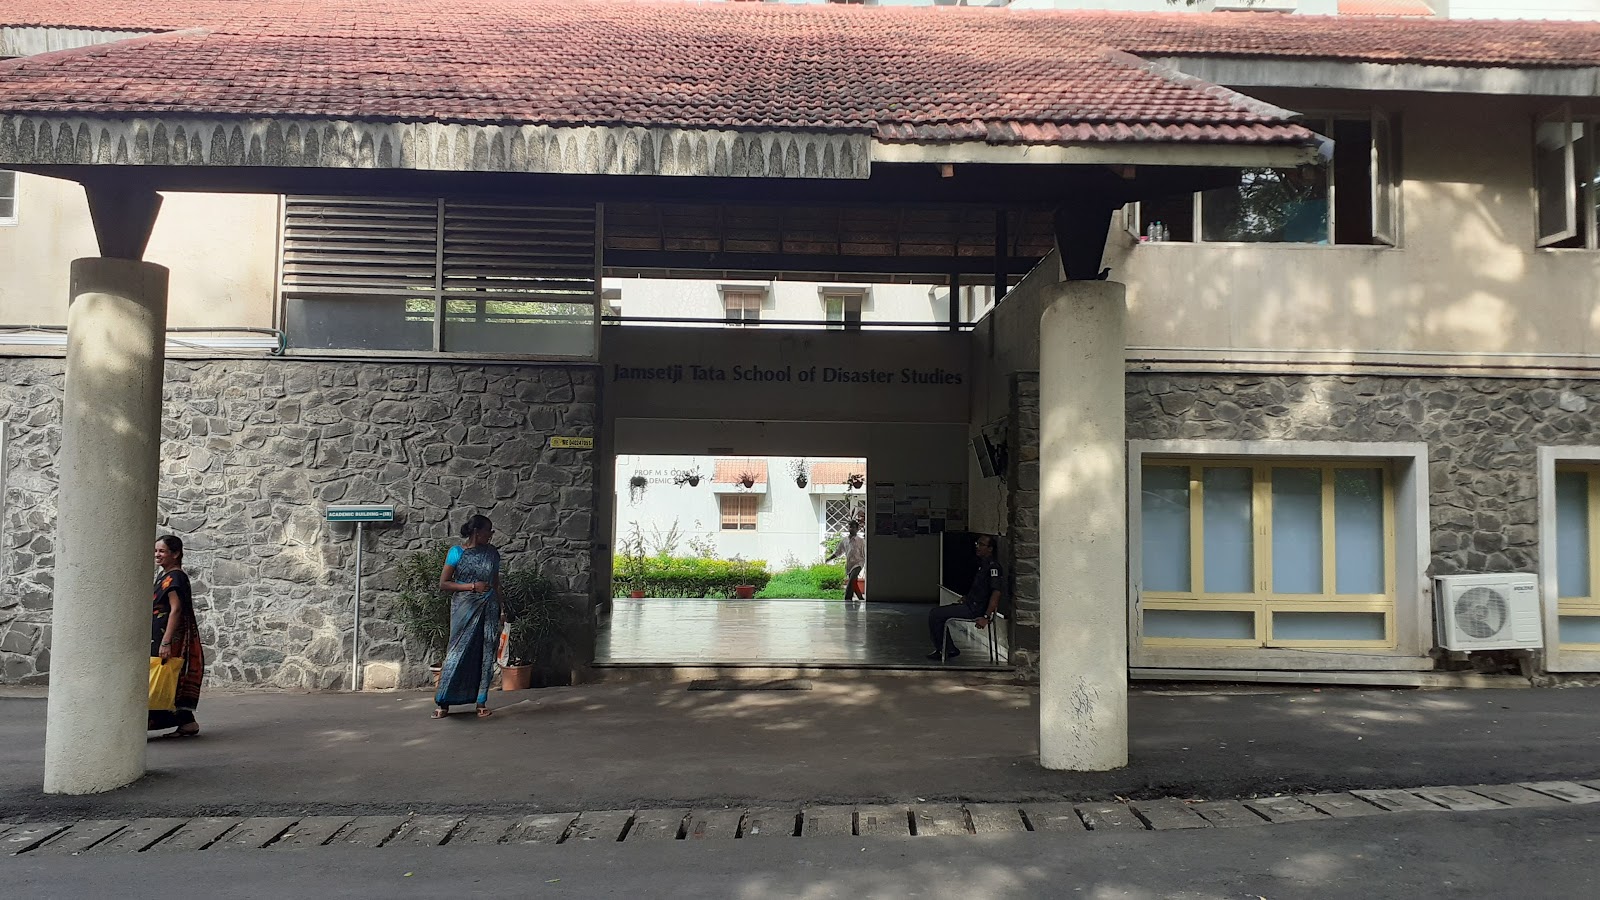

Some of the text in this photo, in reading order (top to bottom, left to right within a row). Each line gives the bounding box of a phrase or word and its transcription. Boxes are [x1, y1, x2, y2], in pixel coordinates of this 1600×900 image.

[613, 364, 963, 385] Jamsetji Tata School of Disaster Studies
